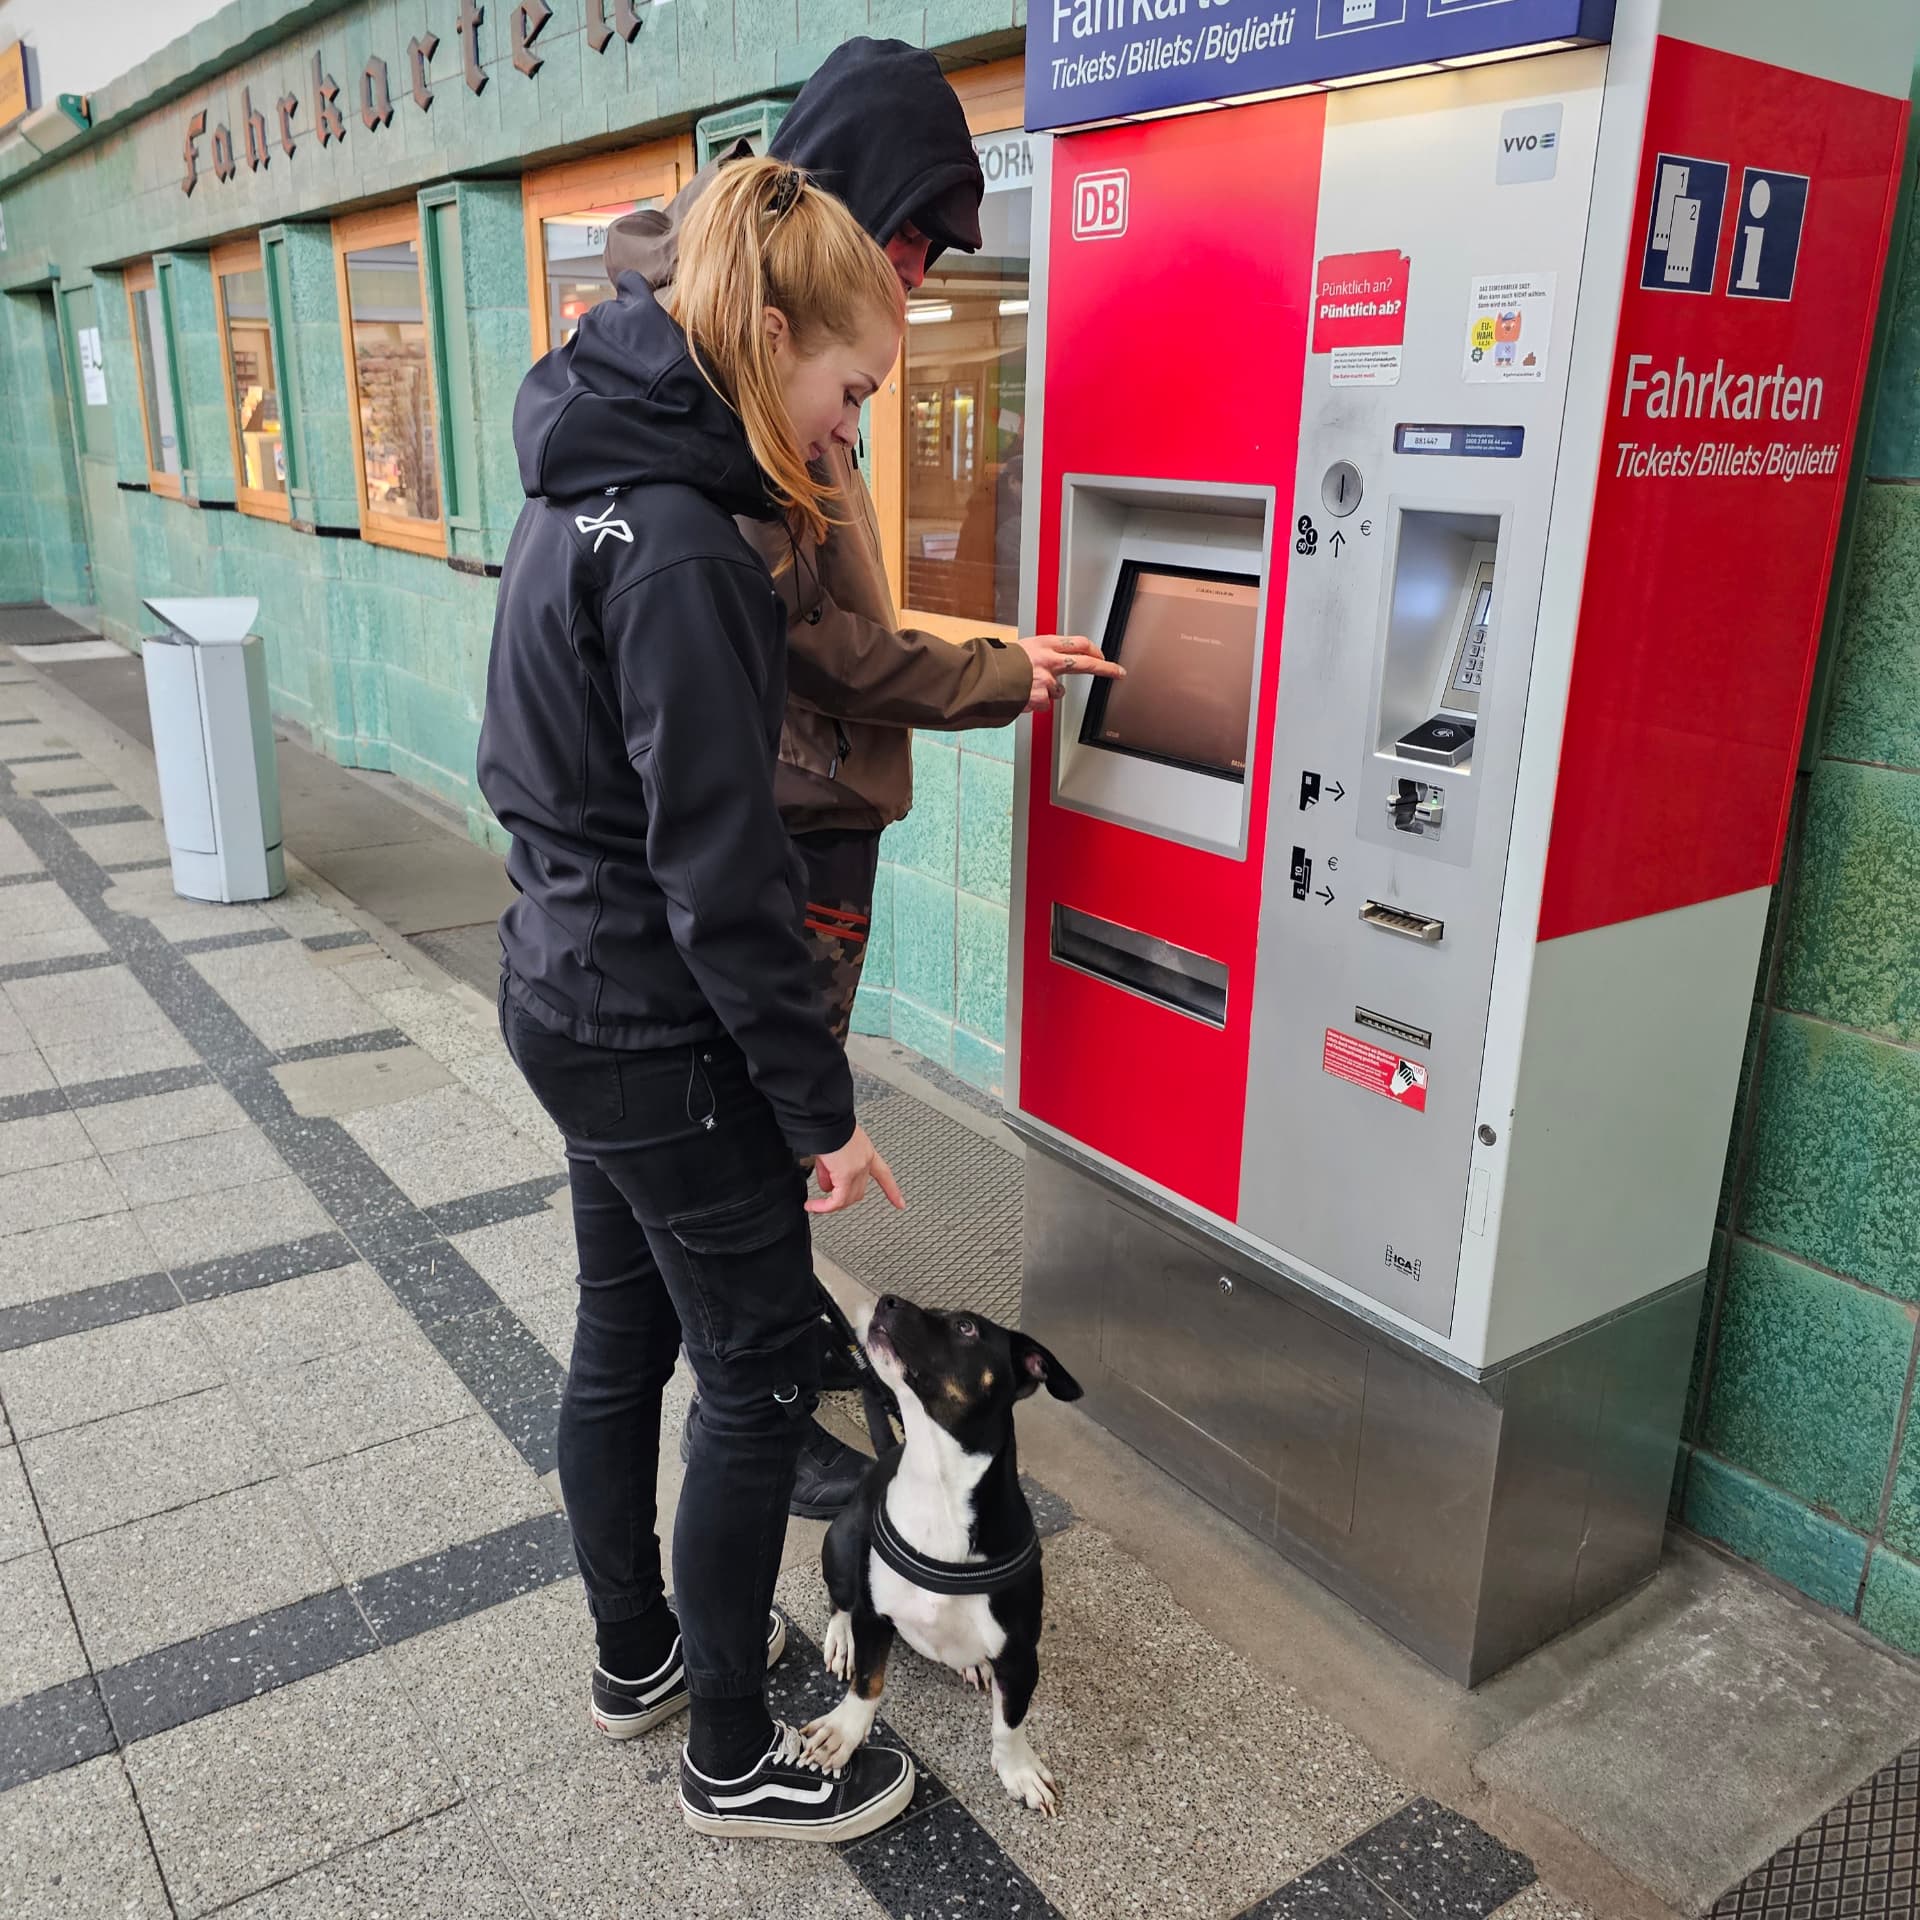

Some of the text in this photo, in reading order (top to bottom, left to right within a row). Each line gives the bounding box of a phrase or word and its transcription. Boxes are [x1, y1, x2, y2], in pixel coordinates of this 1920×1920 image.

[1504, 135, 1538, 152] VVO
[1080, 183, 1120, 228] DB
[1322, 277, 1393, 296] Pünktlich an?
[1320, 300, 1402, 319] Pünktlich ab?
[1476, 331, 1493, 340] WAHL
[1481, 321, 1492, 331] EU-
[1621, 354, 1824, 421] Fahrkarten
[1616, 442, 1840, 483] Tickets/Billets/Biglietti
[1394, 1254, 1412, 1271] ICA
